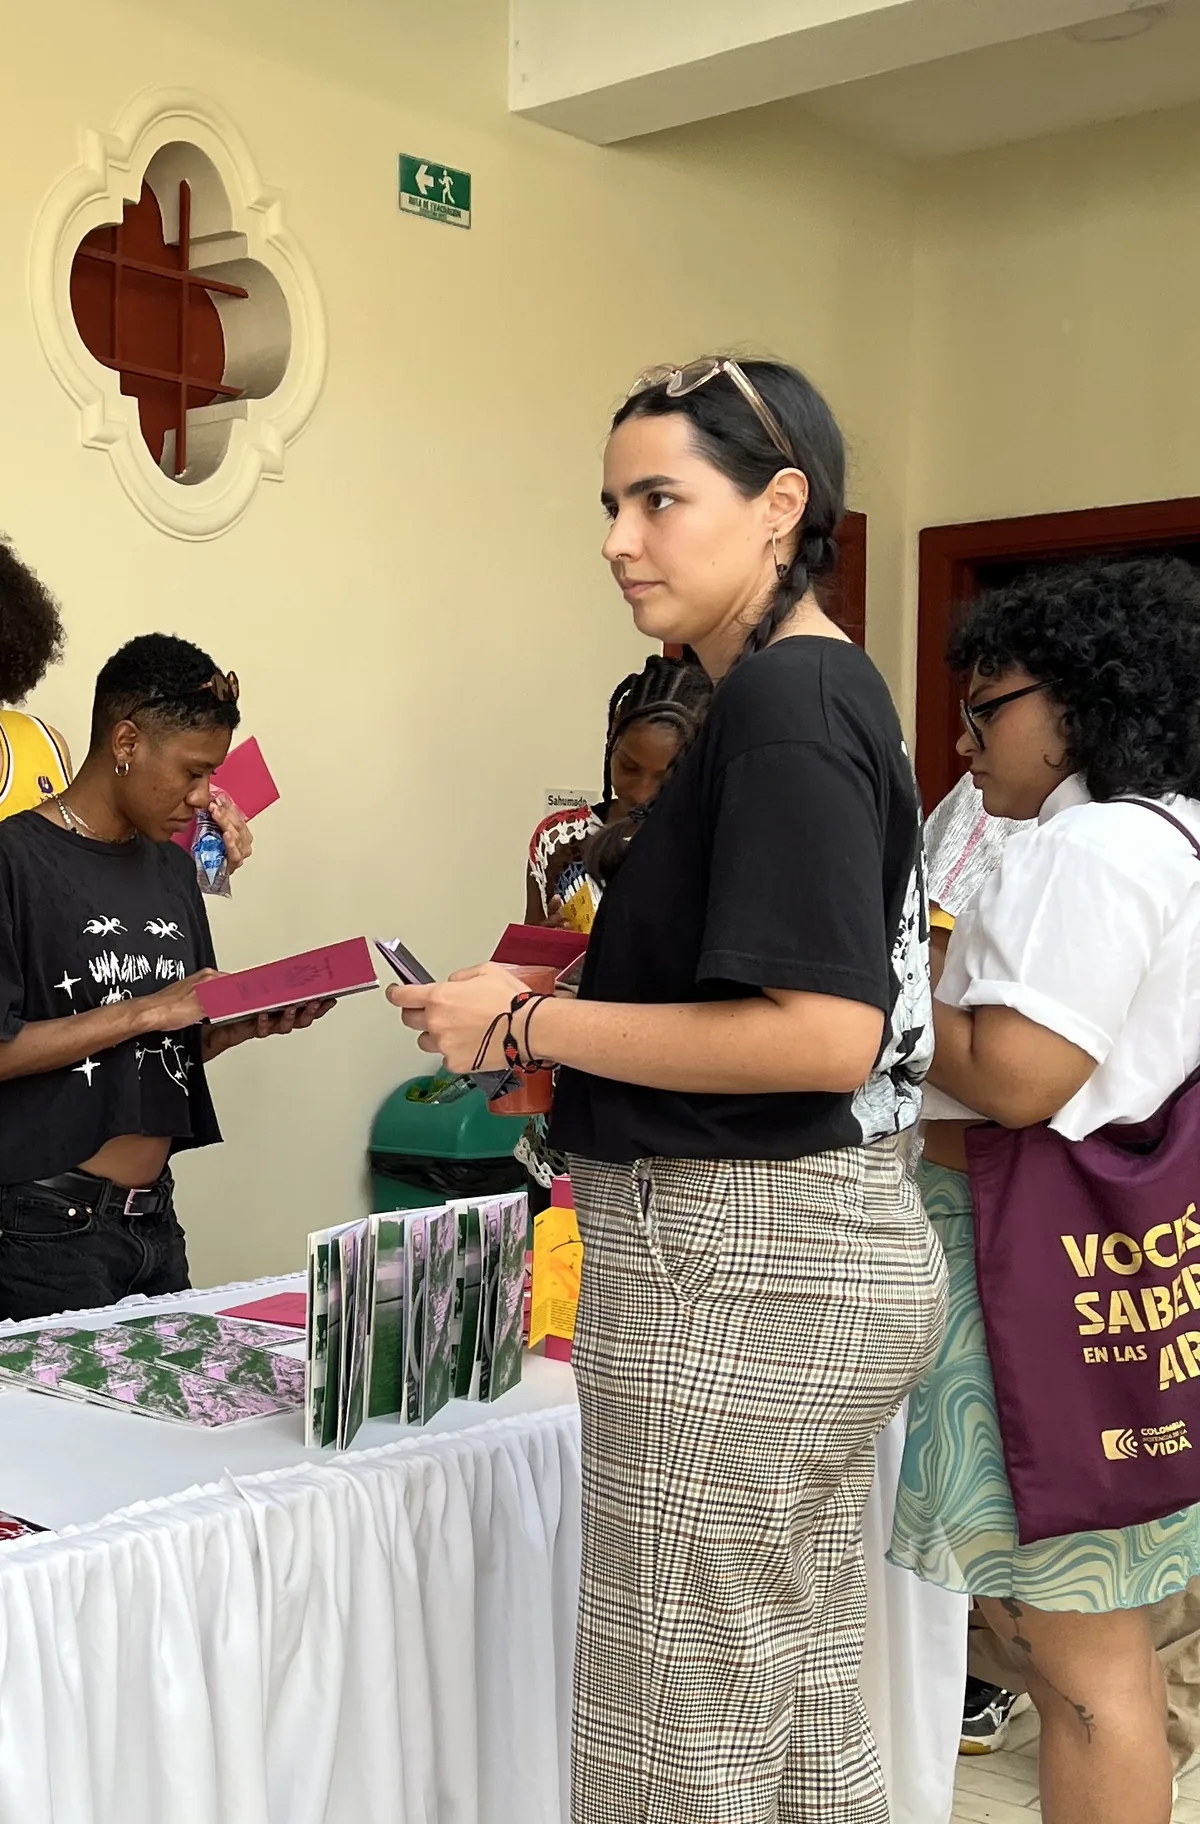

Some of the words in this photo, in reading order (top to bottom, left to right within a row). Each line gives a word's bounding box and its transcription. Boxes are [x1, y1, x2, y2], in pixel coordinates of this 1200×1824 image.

[1083, 1346, 1109, 1363] EN
[1113, 1344, 1148, 1362] LAS
[1143, 1436, 1193, 1457] VIDA
